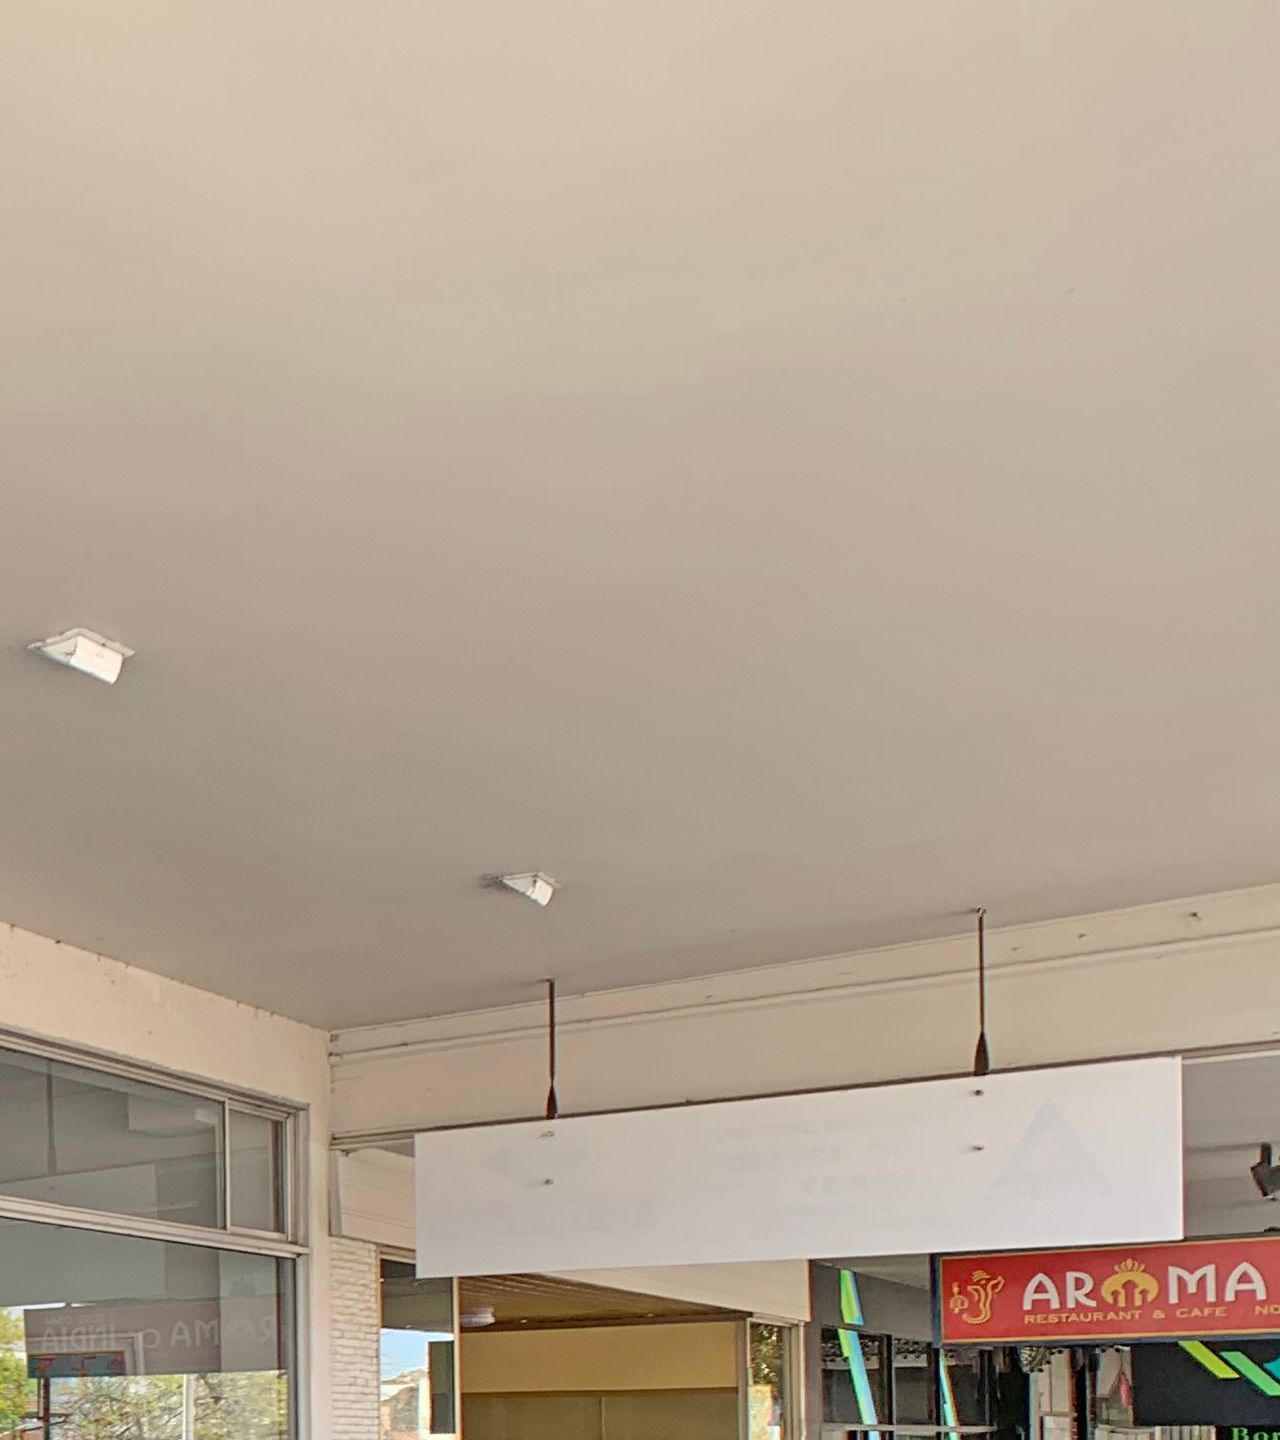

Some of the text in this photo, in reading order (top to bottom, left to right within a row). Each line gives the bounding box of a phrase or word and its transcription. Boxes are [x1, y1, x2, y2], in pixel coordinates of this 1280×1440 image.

[1023, 1259, 1267, 1311] AROMA
[1024, 1309, 1142, 1324] RESTAURANT
[1152, 1309, 1165, 1319] &
[1176, 1306, 1227, 1319] CAFE
